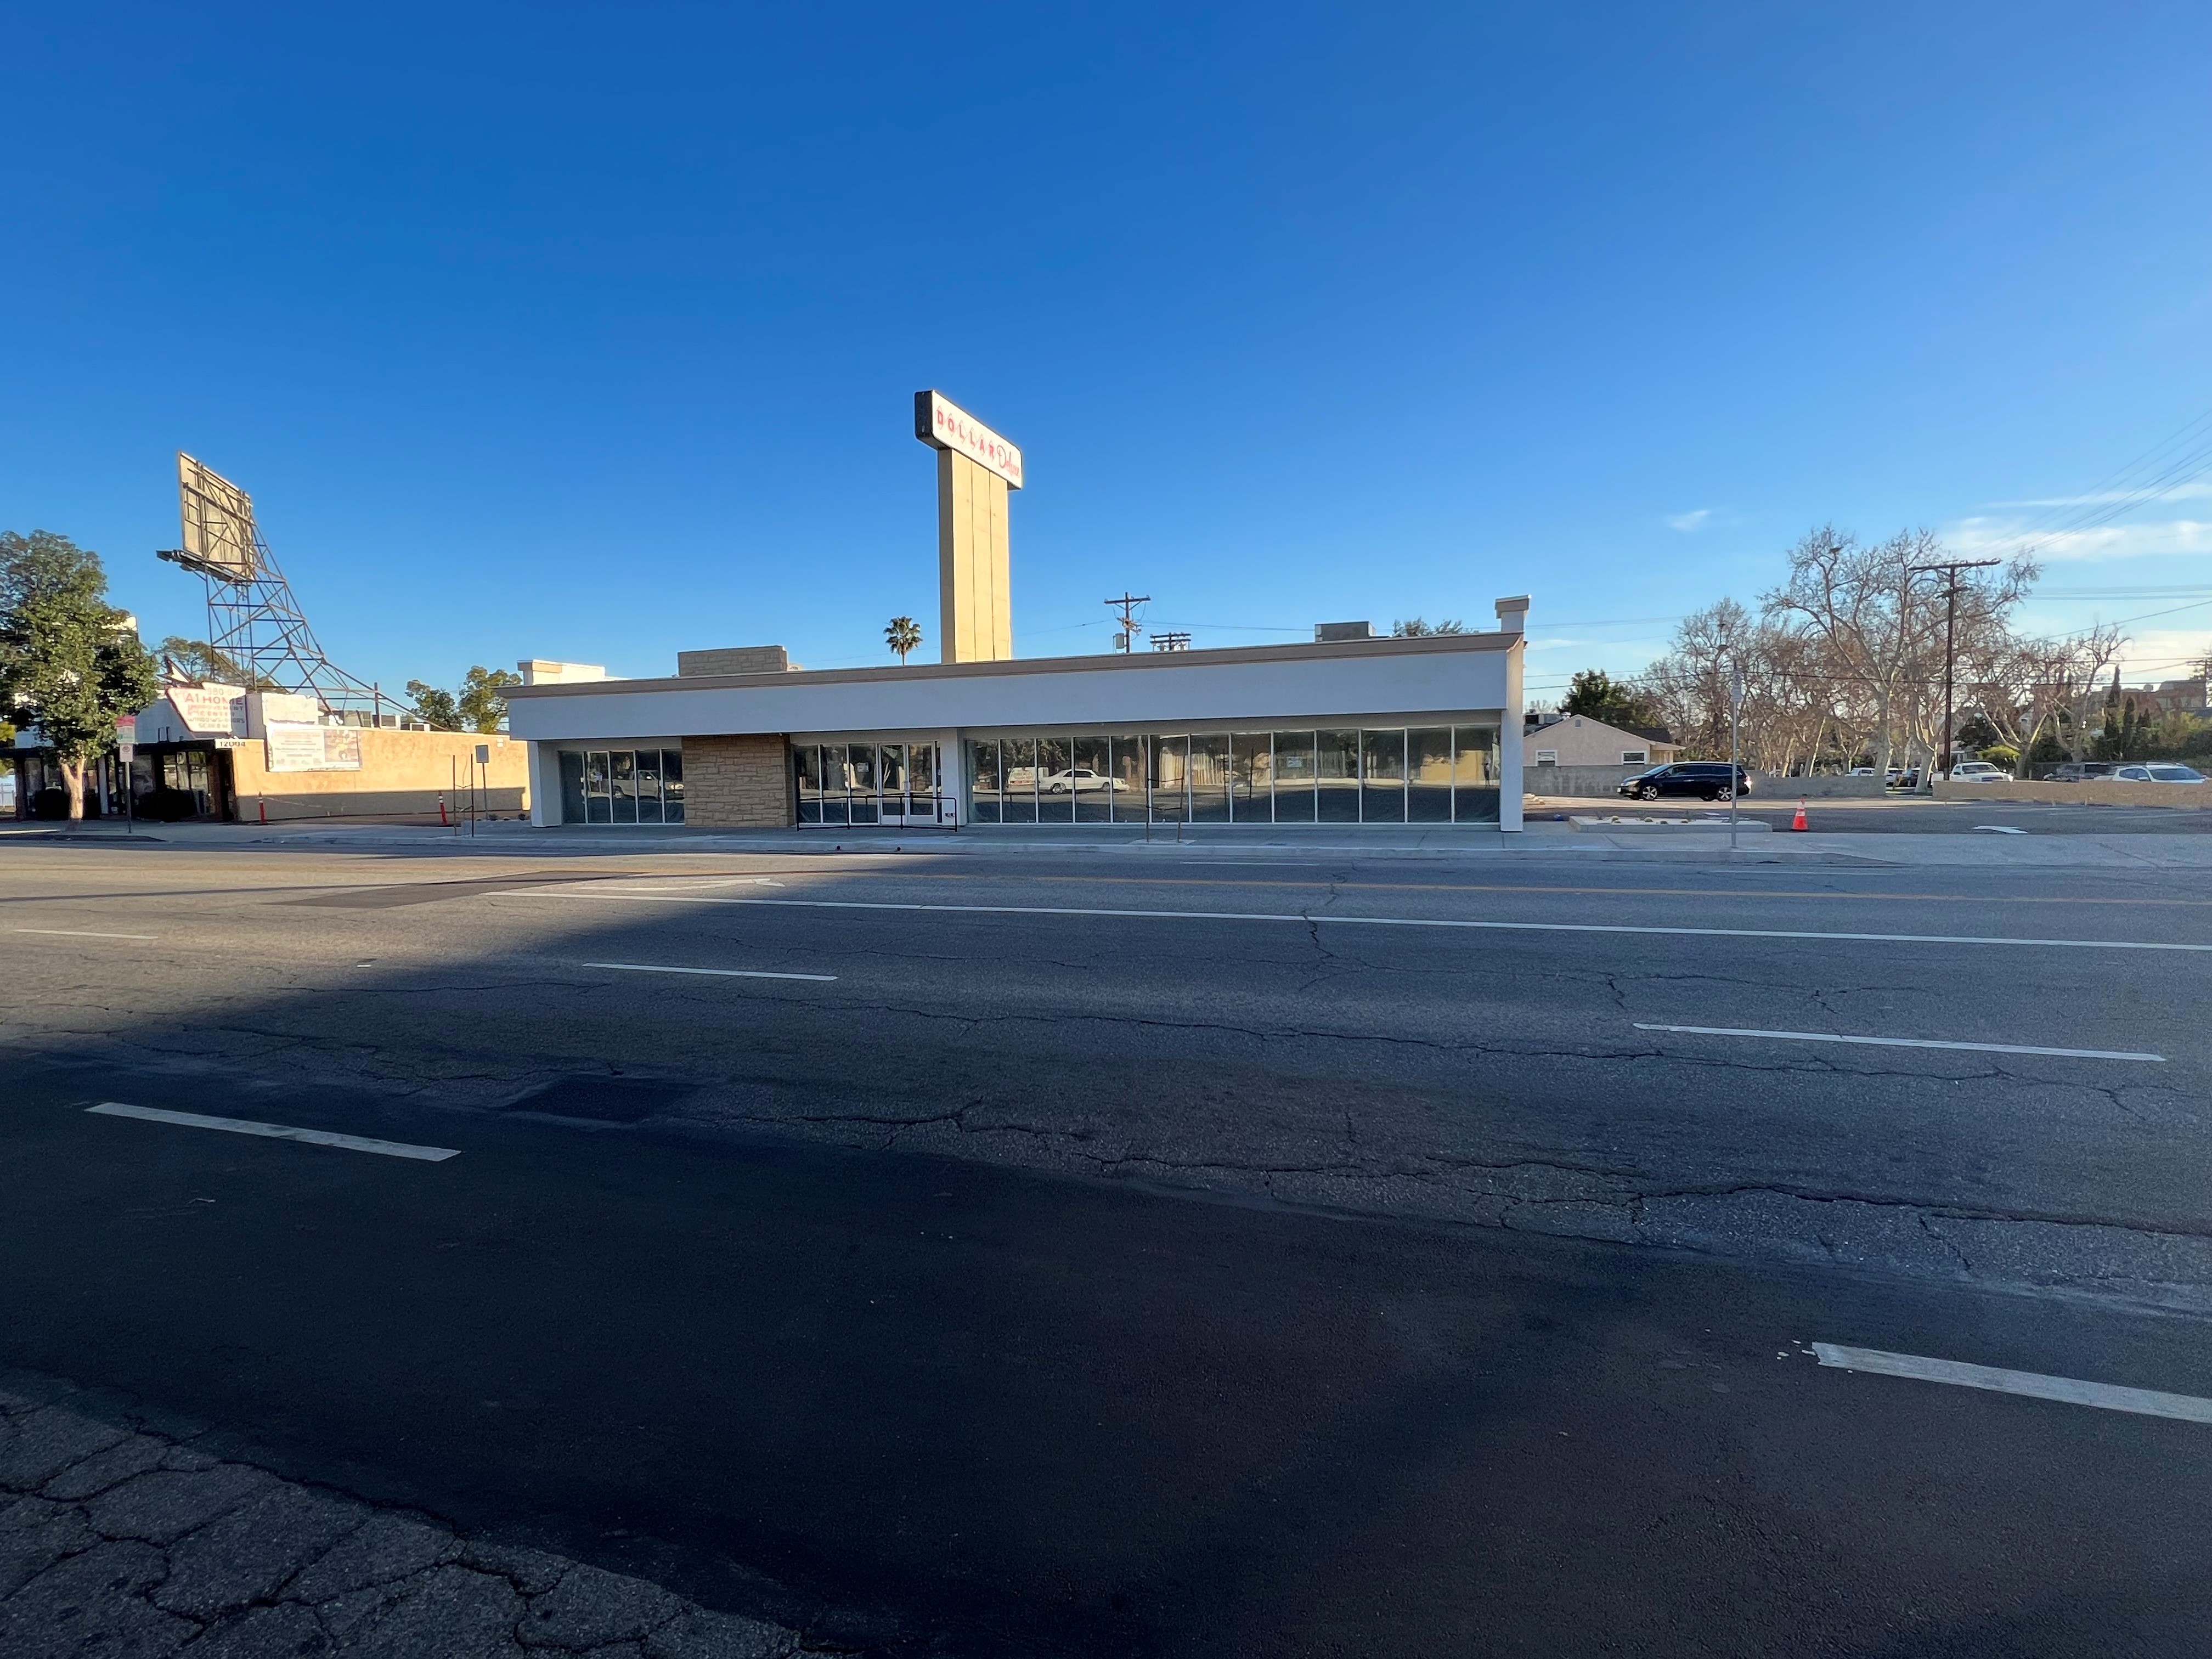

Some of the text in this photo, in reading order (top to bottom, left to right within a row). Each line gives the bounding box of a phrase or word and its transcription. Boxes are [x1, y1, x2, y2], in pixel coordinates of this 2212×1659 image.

[936, 409, 995, 460] DOLLAR
[185, 693, 243, 705] A1 HOME
